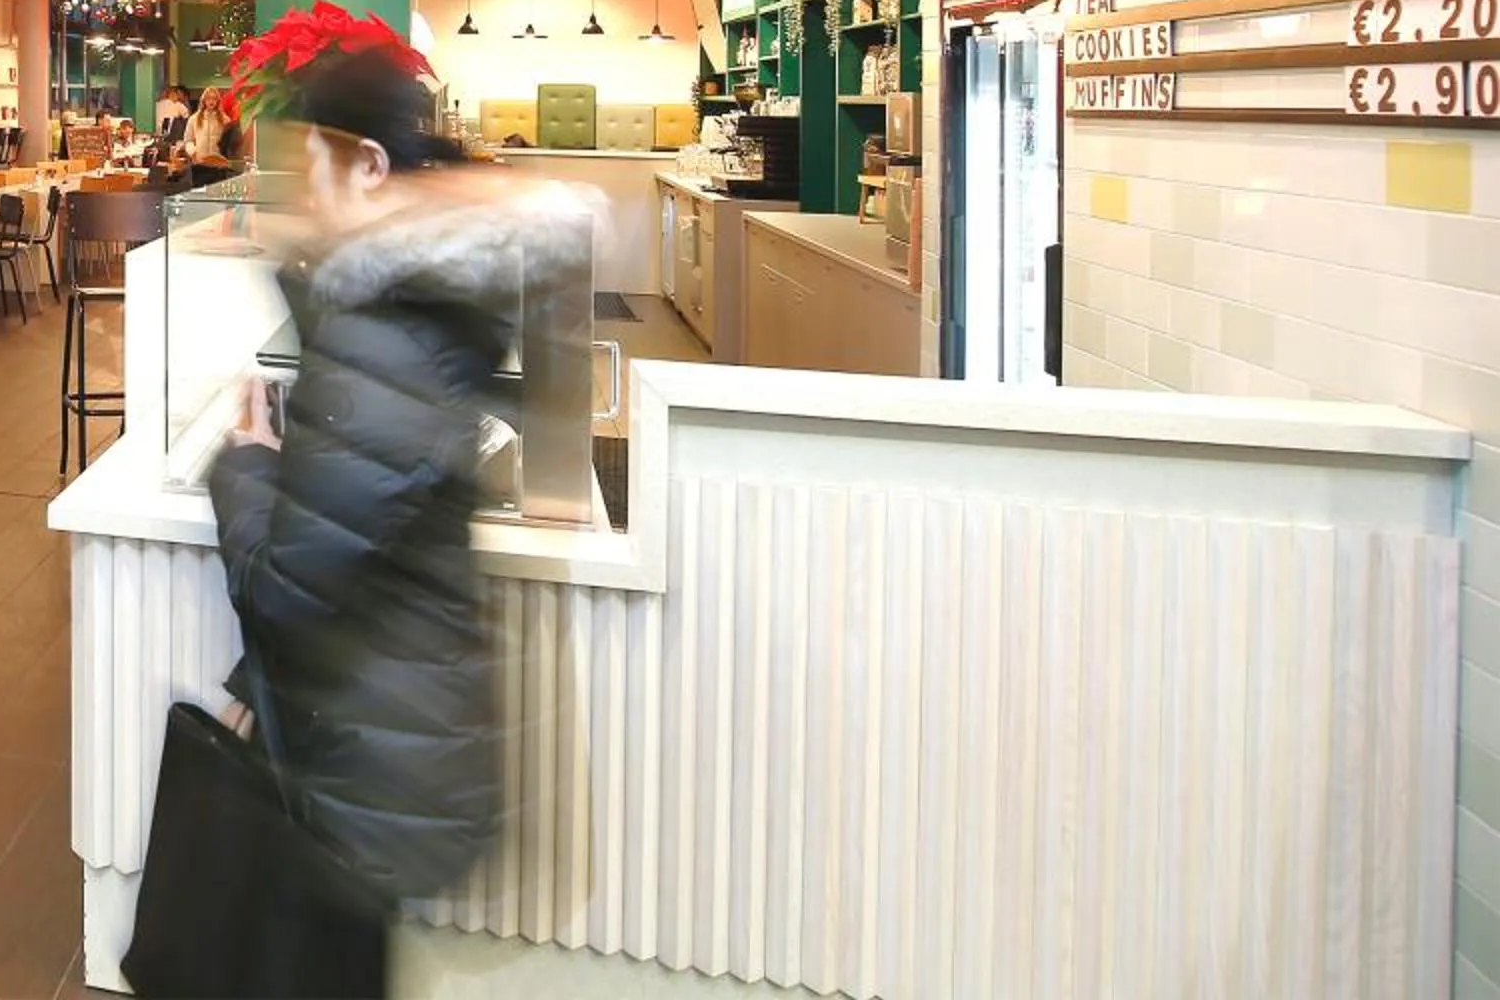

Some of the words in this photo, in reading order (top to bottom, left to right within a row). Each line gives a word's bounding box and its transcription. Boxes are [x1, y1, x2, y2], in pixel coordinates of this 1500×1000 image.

[1075, 24, 1169, 61] COOKIES
[1074, 74, 1172, 109] MUFFINS
[1349, 64, 1500, 115] €2.90
